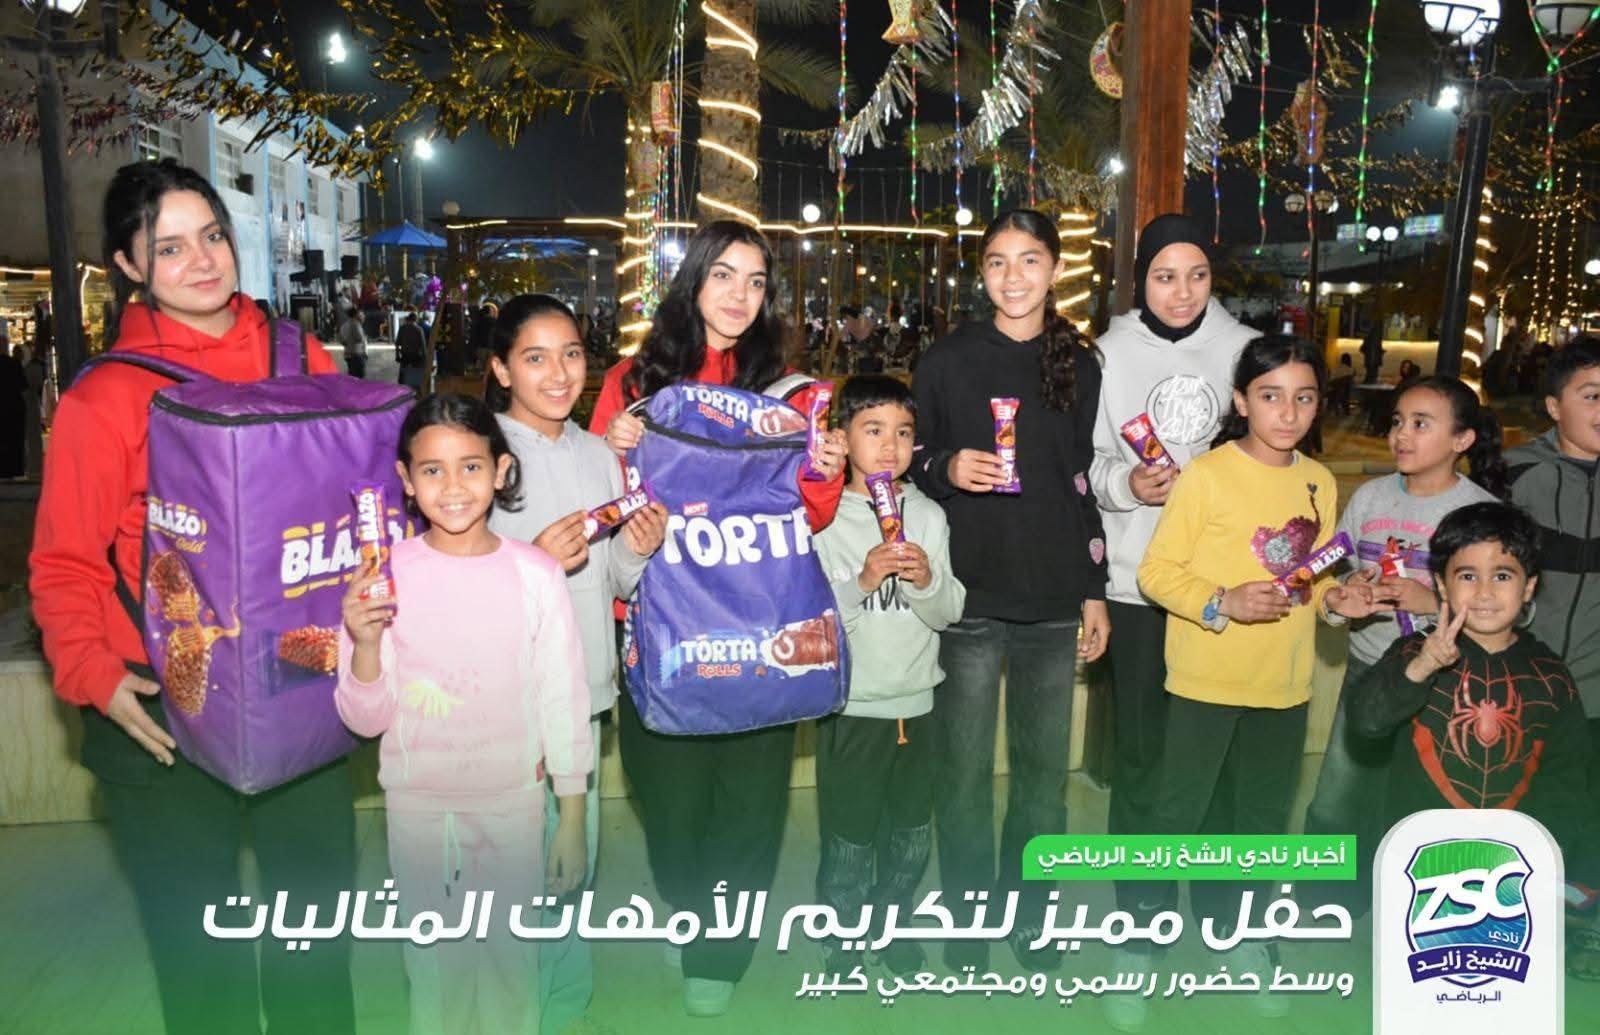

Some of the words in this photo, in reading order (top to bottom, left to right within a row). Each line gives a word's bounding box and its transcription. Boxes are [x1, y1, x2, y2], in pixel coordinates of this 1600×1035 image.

[682, 385, 749, 422] TORTA
[1310, 545, 1345, 575] BLAZO
[680, 640, 758, 663] TORTA
